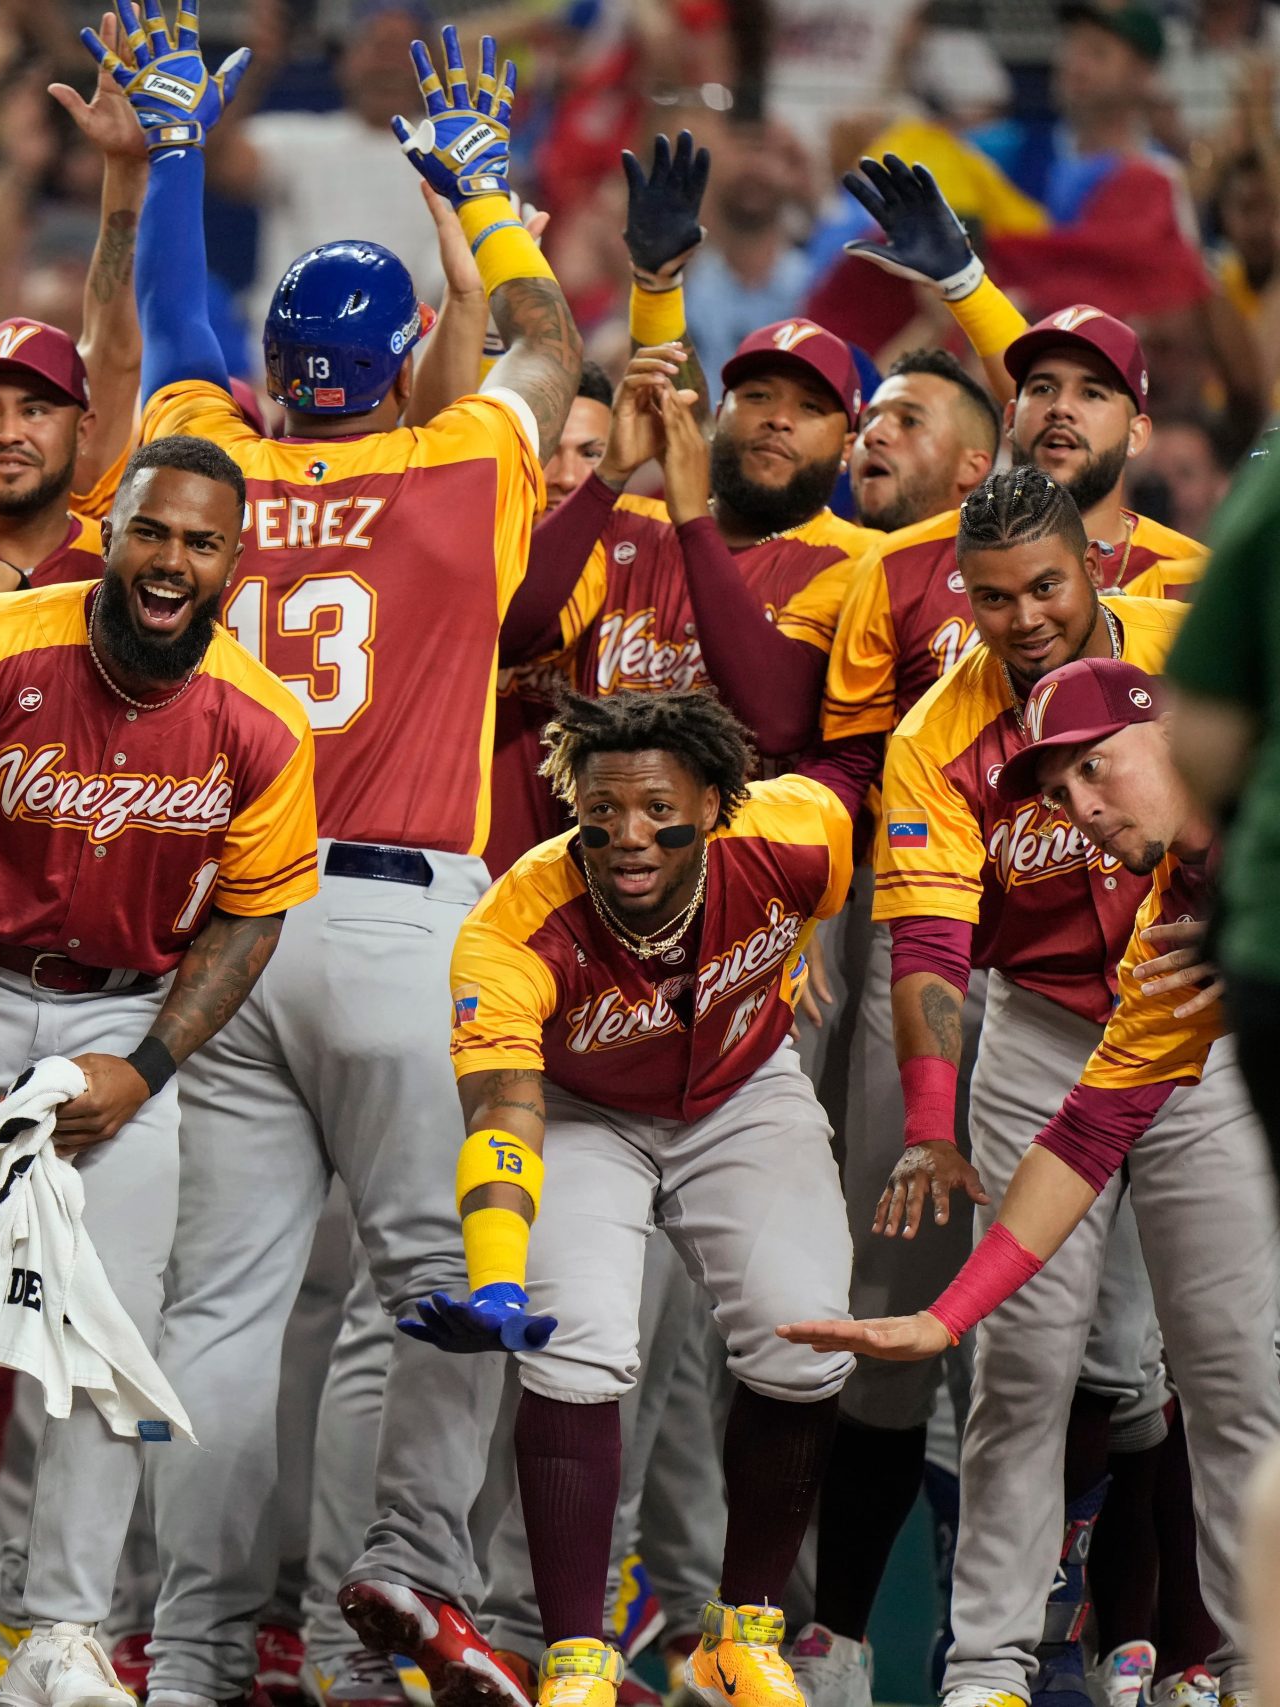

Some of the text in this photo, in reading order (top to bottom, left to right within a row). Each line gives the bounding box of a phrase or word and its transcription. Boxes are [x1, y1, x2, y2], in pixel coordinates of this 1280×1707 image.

[307, 356, 330, 379] 13
[222, 571, 377, 736] 13
[1026, 681, 1058, 742] V
[172, 858, 221, 932] 1
[496, 1149, 523, 1175] 13
[7, 1267, 42, 1313] DE
